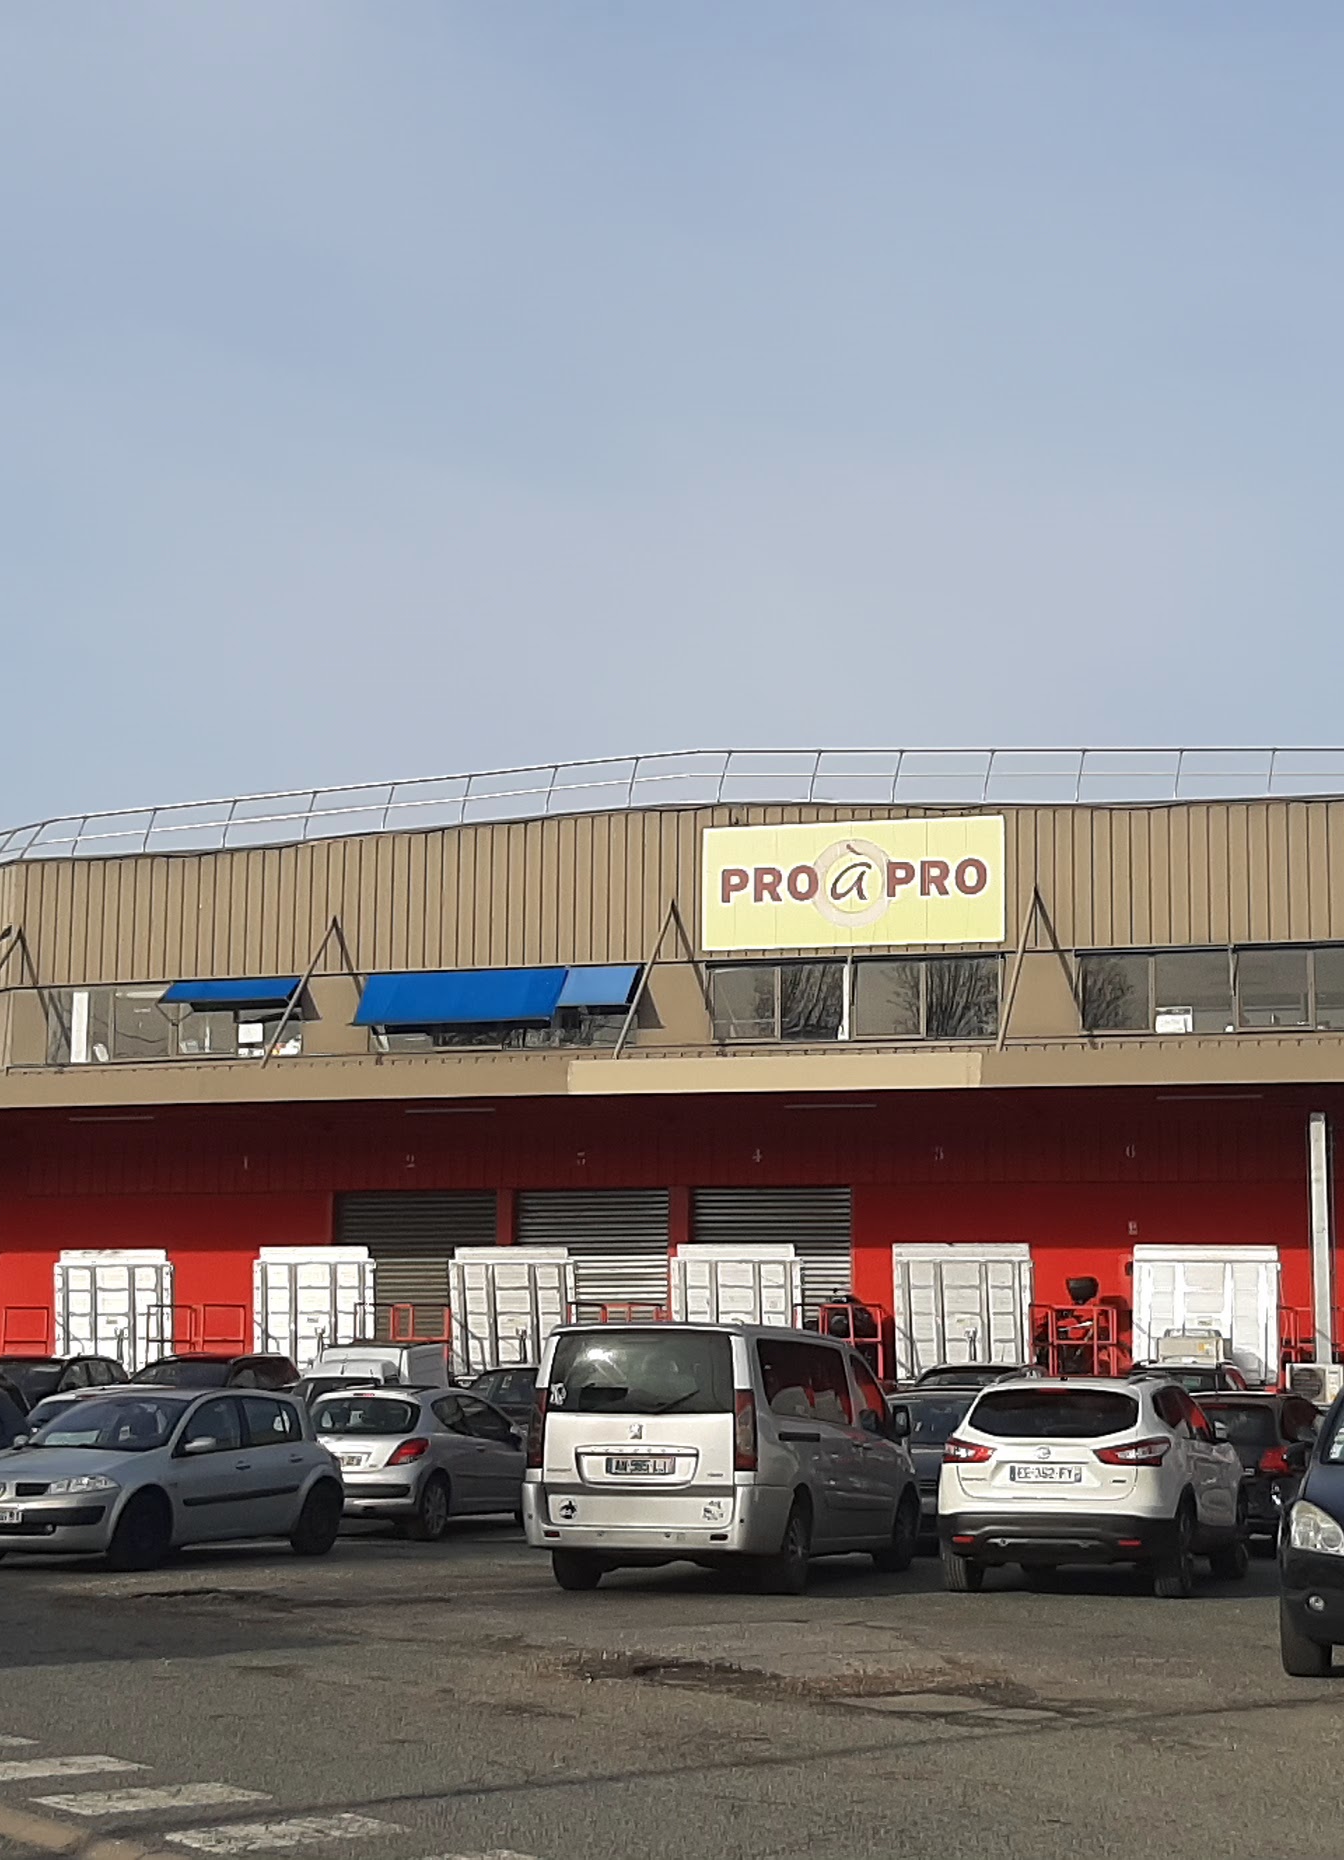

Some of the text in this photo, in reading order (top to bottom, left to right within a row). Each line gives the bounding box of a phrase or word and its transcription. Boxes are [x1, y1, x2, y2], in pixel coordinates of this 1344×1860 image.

[720, 843, 988, 903] PRO à PRO
